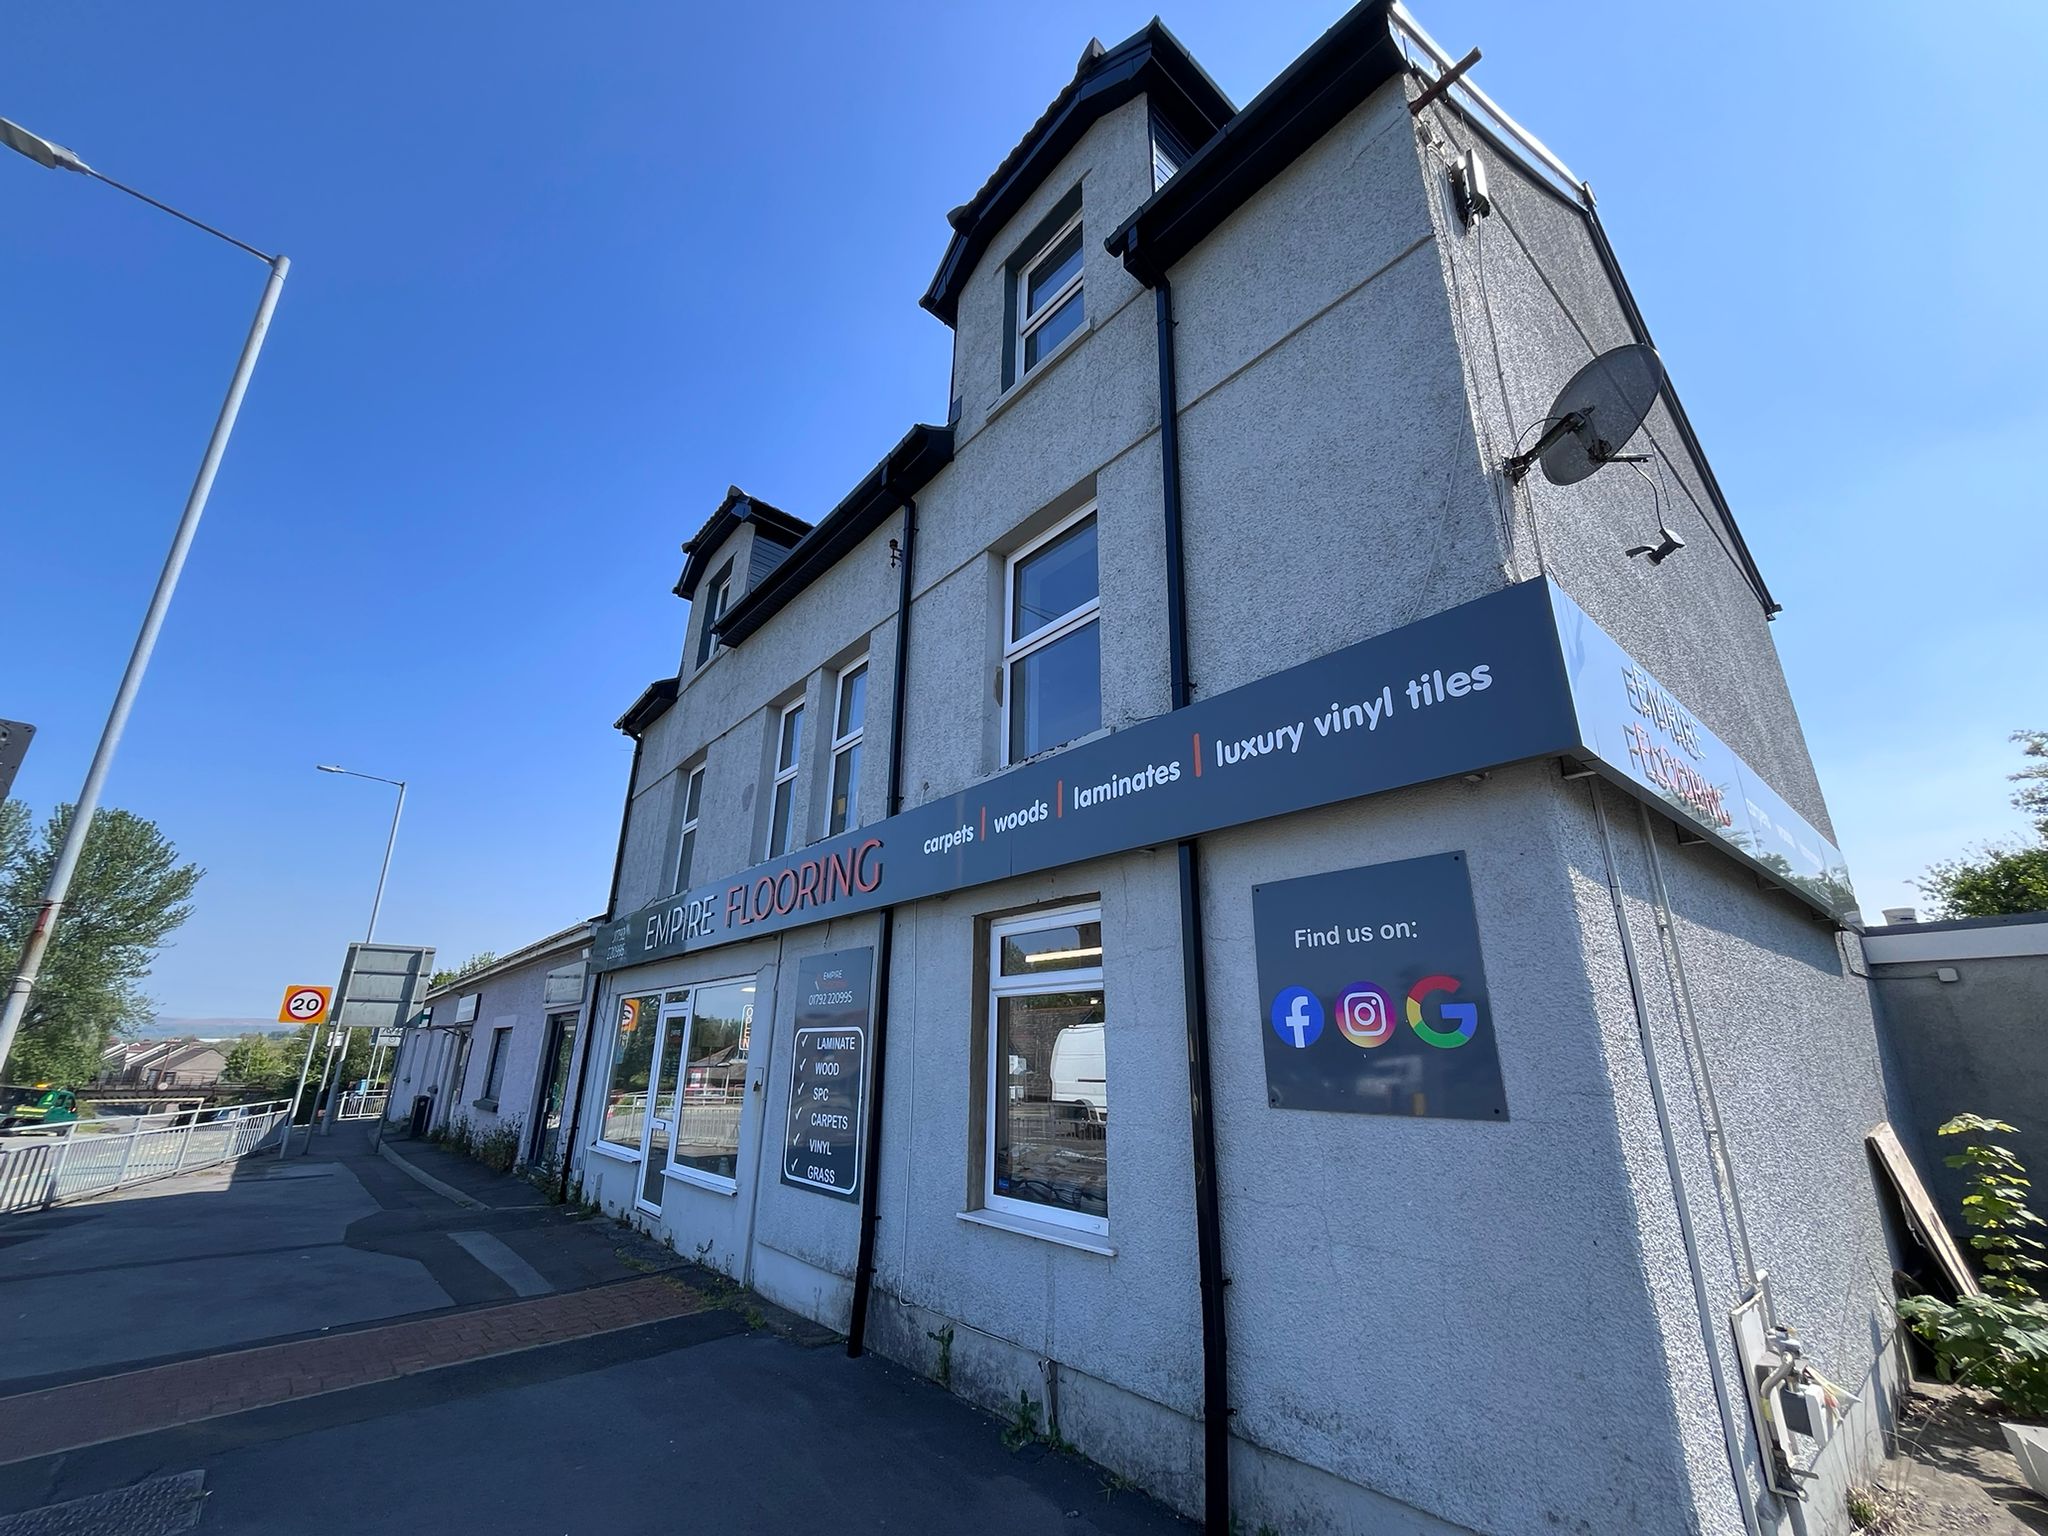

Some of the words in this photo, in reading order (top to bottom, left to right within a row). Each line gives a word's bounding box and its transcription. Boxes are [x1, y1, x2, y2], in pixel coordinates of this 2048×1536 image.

[923, 821, 975, 855] carpets
[993, 799, 1049, 834] woods
[1072, 758, 1182, 810] laminates
[1215, 720, 1304, 768] luxury
[1313, 686, 1393, 738] vinyl
[1405, 662, 1494, 710] tiles
[644, 894, 718, 951] EMPIRE
[724, 838, 884, 929] FLOORING
[1294, 925, 1341, 949] Find
[1346, 925, 1374, 944] us
[1380, 920, 1418, 941] on:
[291, 997, 320, 1011] 20
[827, 990, 853, 1005] 220995
[743, 1006, 754, 1049] OPEN
[816, 1036, 856, 1051] LAMINATE
[814, 1061, 840, 1077] WOOD
[812, 1086, 830, 1102] SPC
[810, 1111, 849, 1131] CARPETS
[809, 1138, 832, 1156] VINYL
[806, 1164, 836, 1185] GRASS
